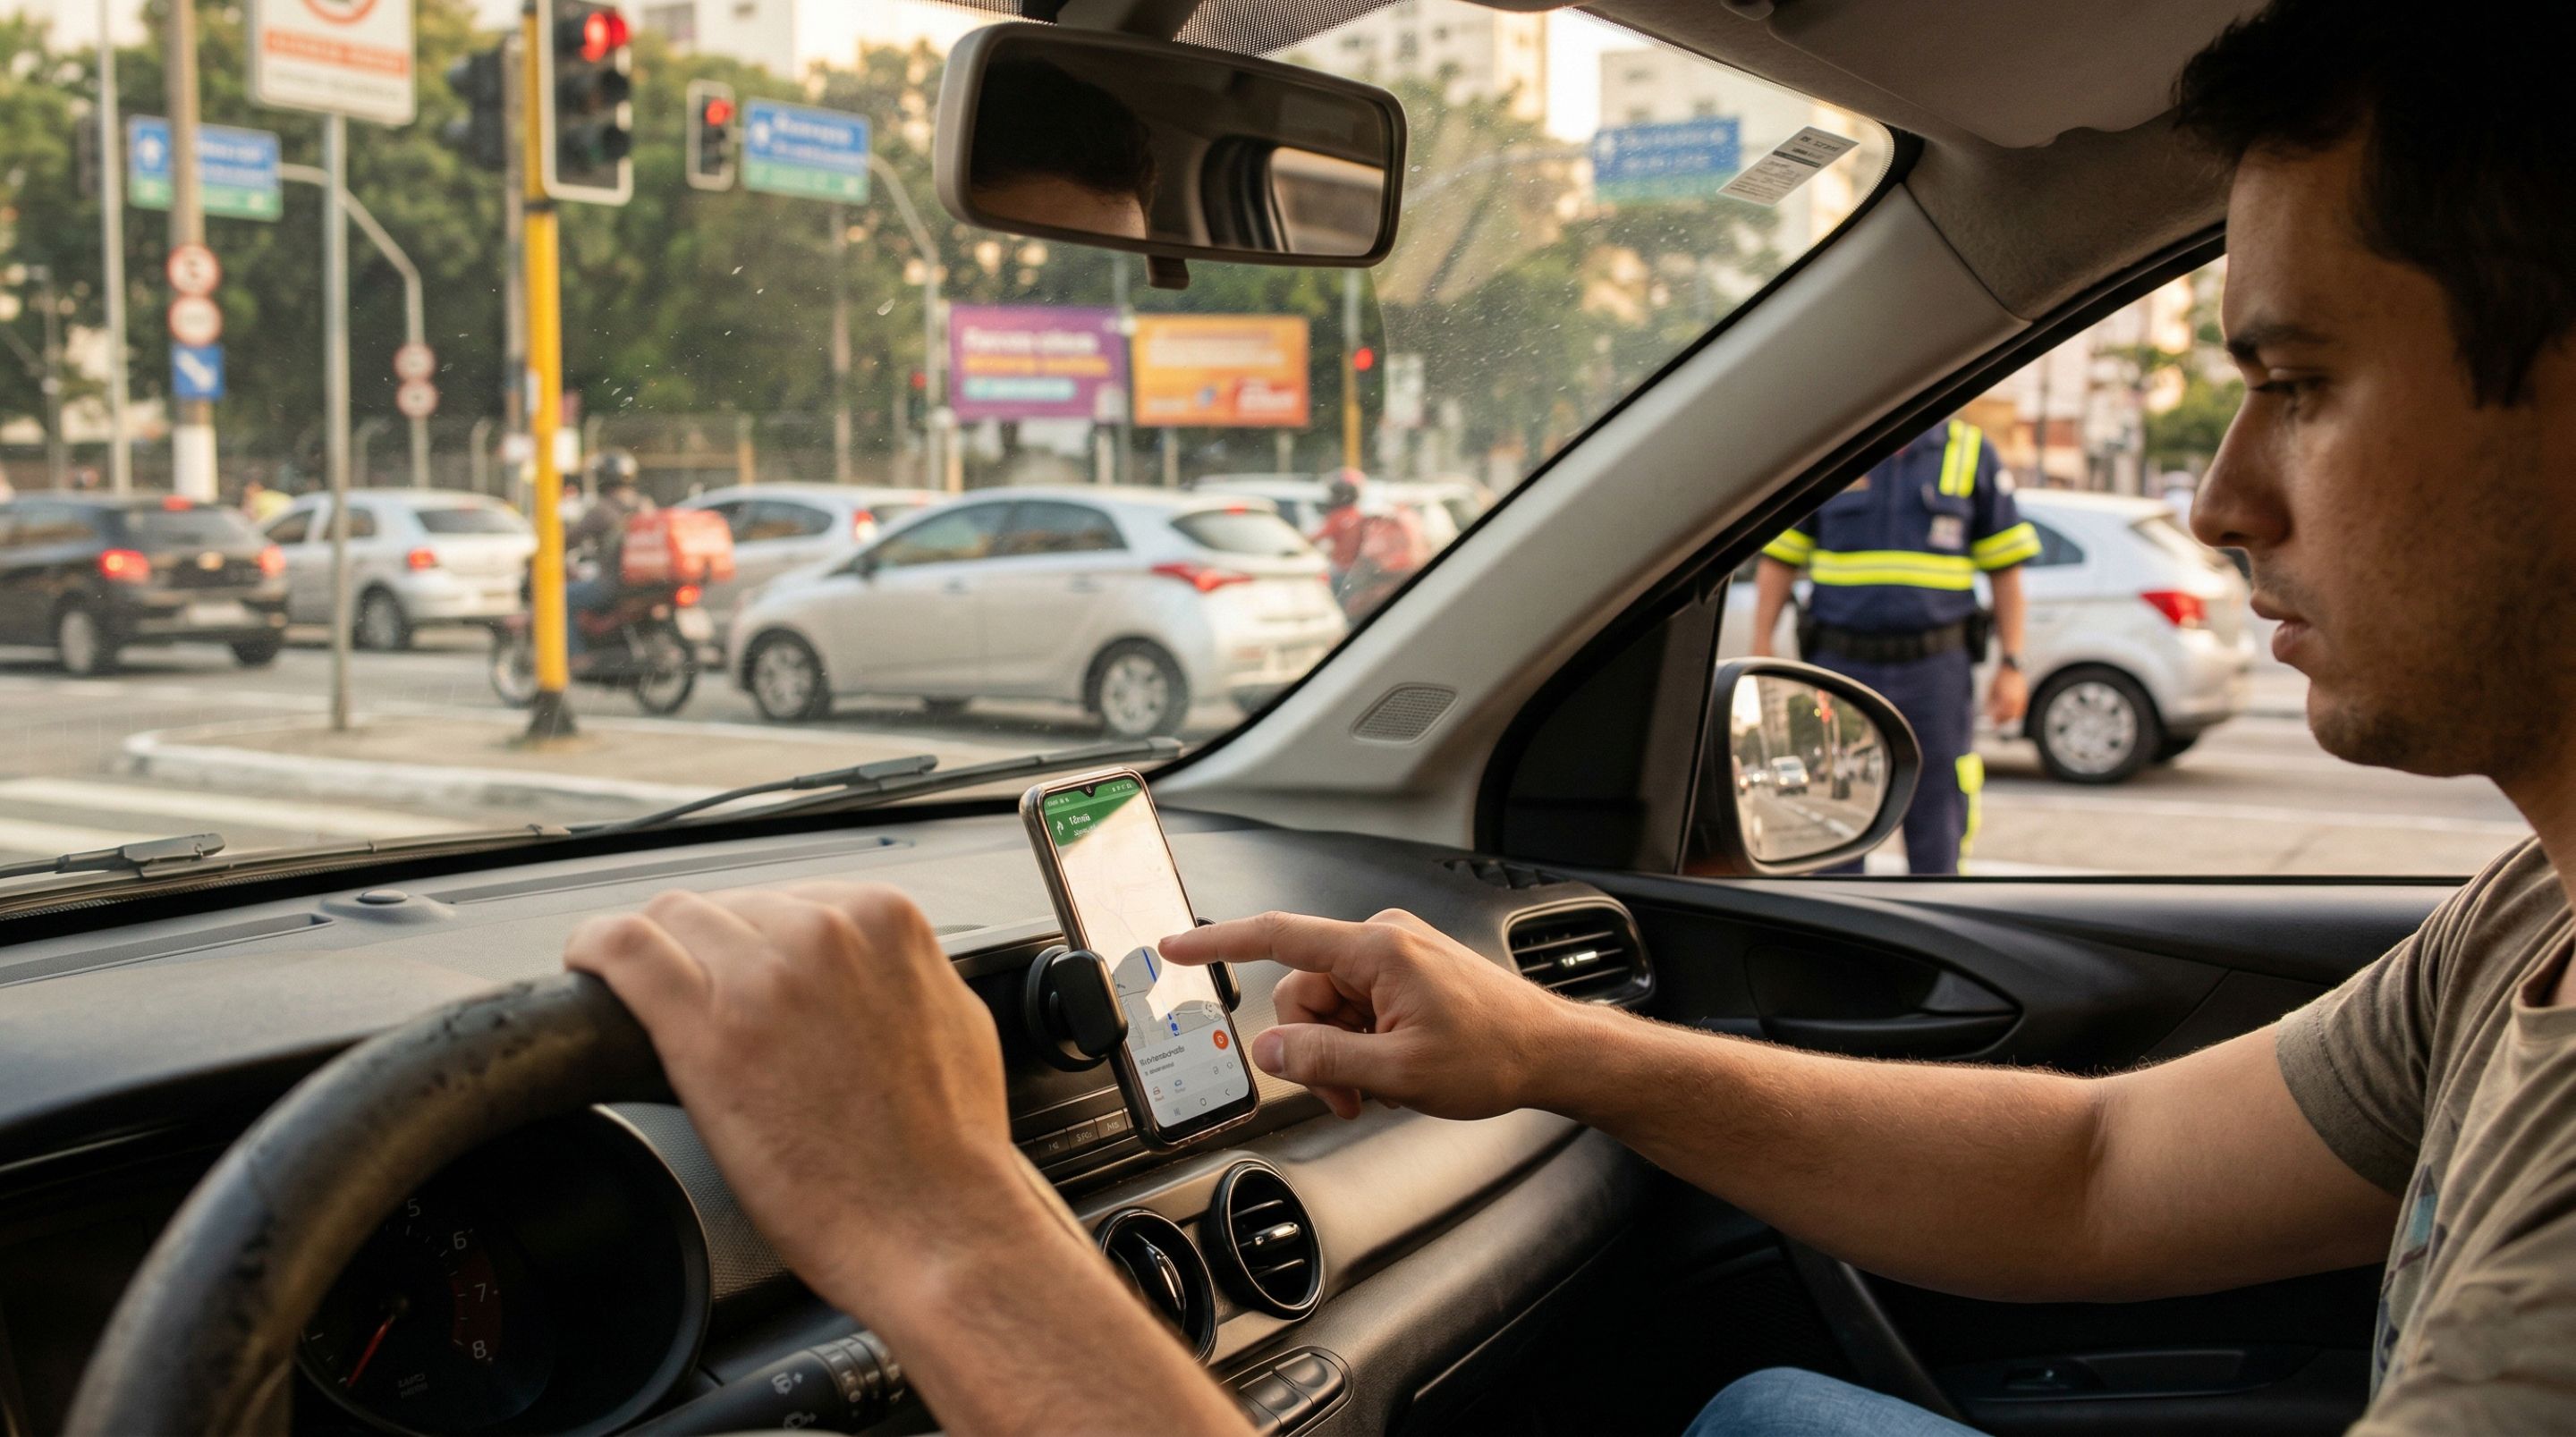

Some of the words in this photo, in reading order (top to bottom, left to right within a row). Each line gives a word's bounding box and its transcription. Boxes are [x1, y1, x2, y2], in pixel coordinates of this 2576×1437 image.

[407, 1198, 420, 1217] 5
[453, 1231, 467, 1250] 6
[474, 1282, 487, 1302] 7
[472, 1340, 487, 1359] 8
